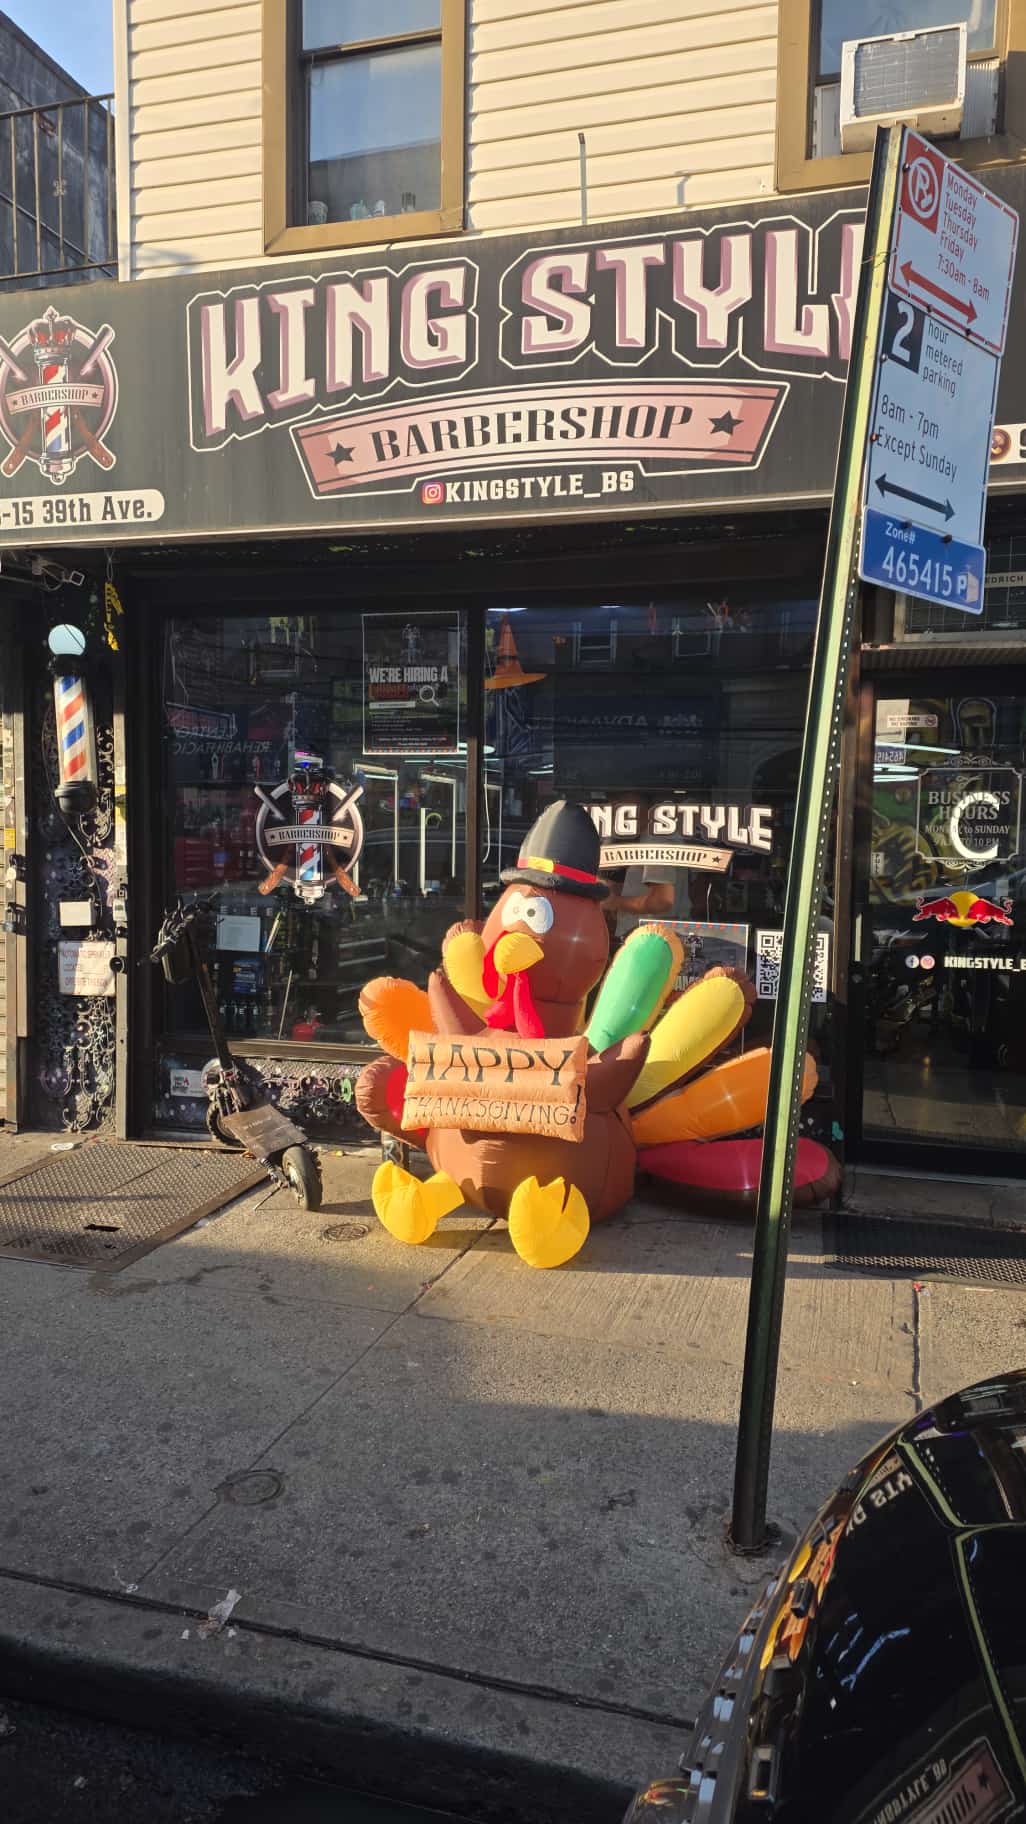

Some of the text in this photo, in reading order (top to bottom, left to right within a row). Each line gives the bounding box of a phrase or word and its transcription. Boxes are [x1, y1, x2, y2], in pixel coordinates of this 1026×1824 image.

[946, 172, 978, 209] Monday
[945, 191, 977, 227] Tuesday
[939, 230, 965, 264] Friday
[942, 211, 978, 251] Thursday
[937, 254, 966, 288] 7:30am
[972, 277, 990, 304] 8am
[891, 299, 914, 362] 2
[928, 319, 949, 345] hour
[200, 267, 467, 437] KING
[925, 344, 963, 377] metered
[20, 388, 89, 406] BARBERSHOP
[922, 366, 956, 398] parking
[371, 404, 693, 463] BARBERSHOP
[881, 395, 905, 424] 8am
[918, 411, 939, 441] 7pm
[876, 425, 958, 483] Except Sunday
[445, 470, 634, 503] KINGSTYLE_BS
[0, 495, 153, 526] -15 39th Ave.
[885, 521, 916, 545] Zone#
[882, 545, 953, 597] 465415
[369, 665, 449, 683] WE'RE HIRING A
[652, 805, 772, 850] STYLE
[974, 825, 1010, 834] SUNDAY
[604, 849, 708, 864] BARBERSHOP
[408, 1042, 574, 1086] HAPPY
[406, 1084, 583, 1126] THANKSGIVING!
